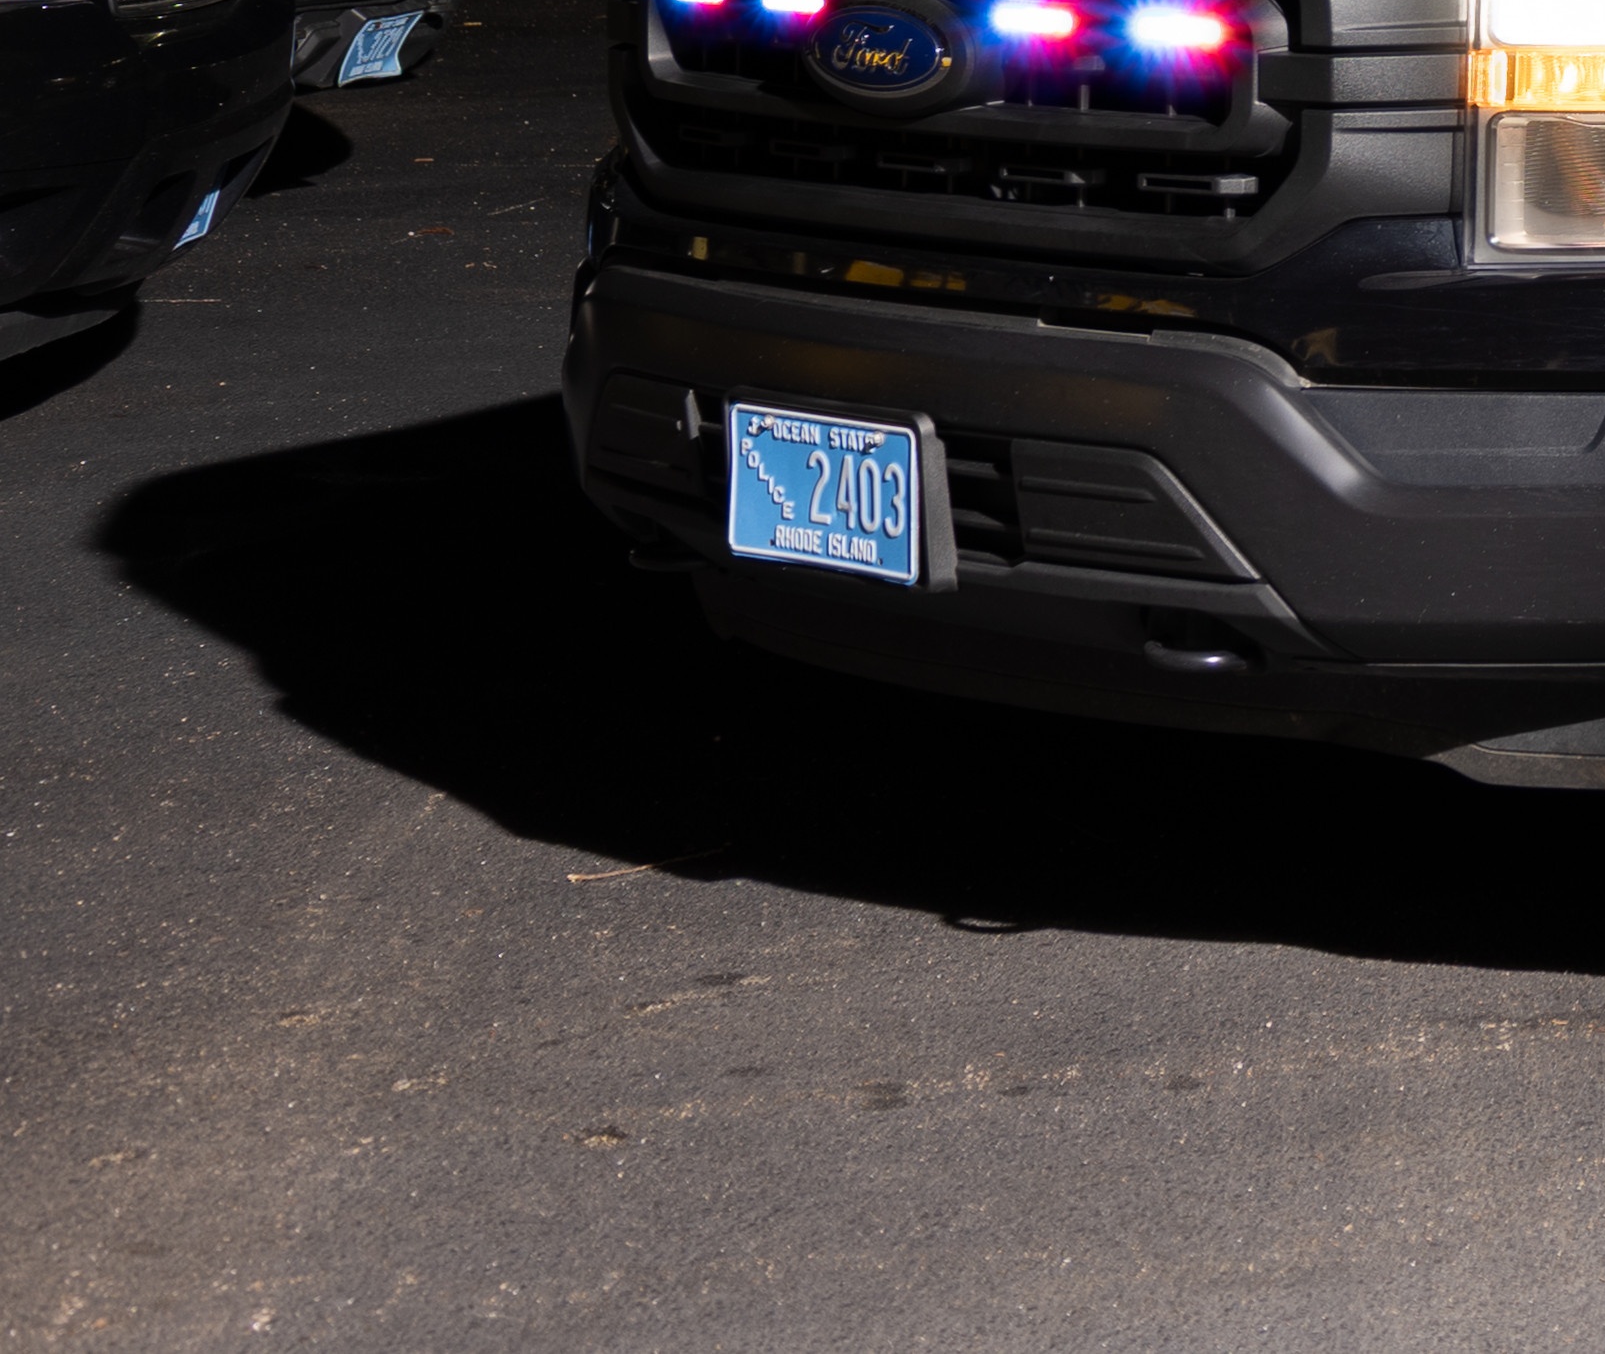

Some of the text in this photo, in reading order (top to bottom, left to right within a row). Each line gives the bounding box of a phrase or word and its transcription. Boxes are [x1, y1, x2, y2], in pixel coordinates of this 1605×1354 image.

[832, 19, 914, 75] Ford
[772, 418, 820, 445] OCEAN
[740, 437, 795, 520] POLICE
[807, 449, 906, 538] 2403
[775, 524, 877, 563] RHODE ISLAND
